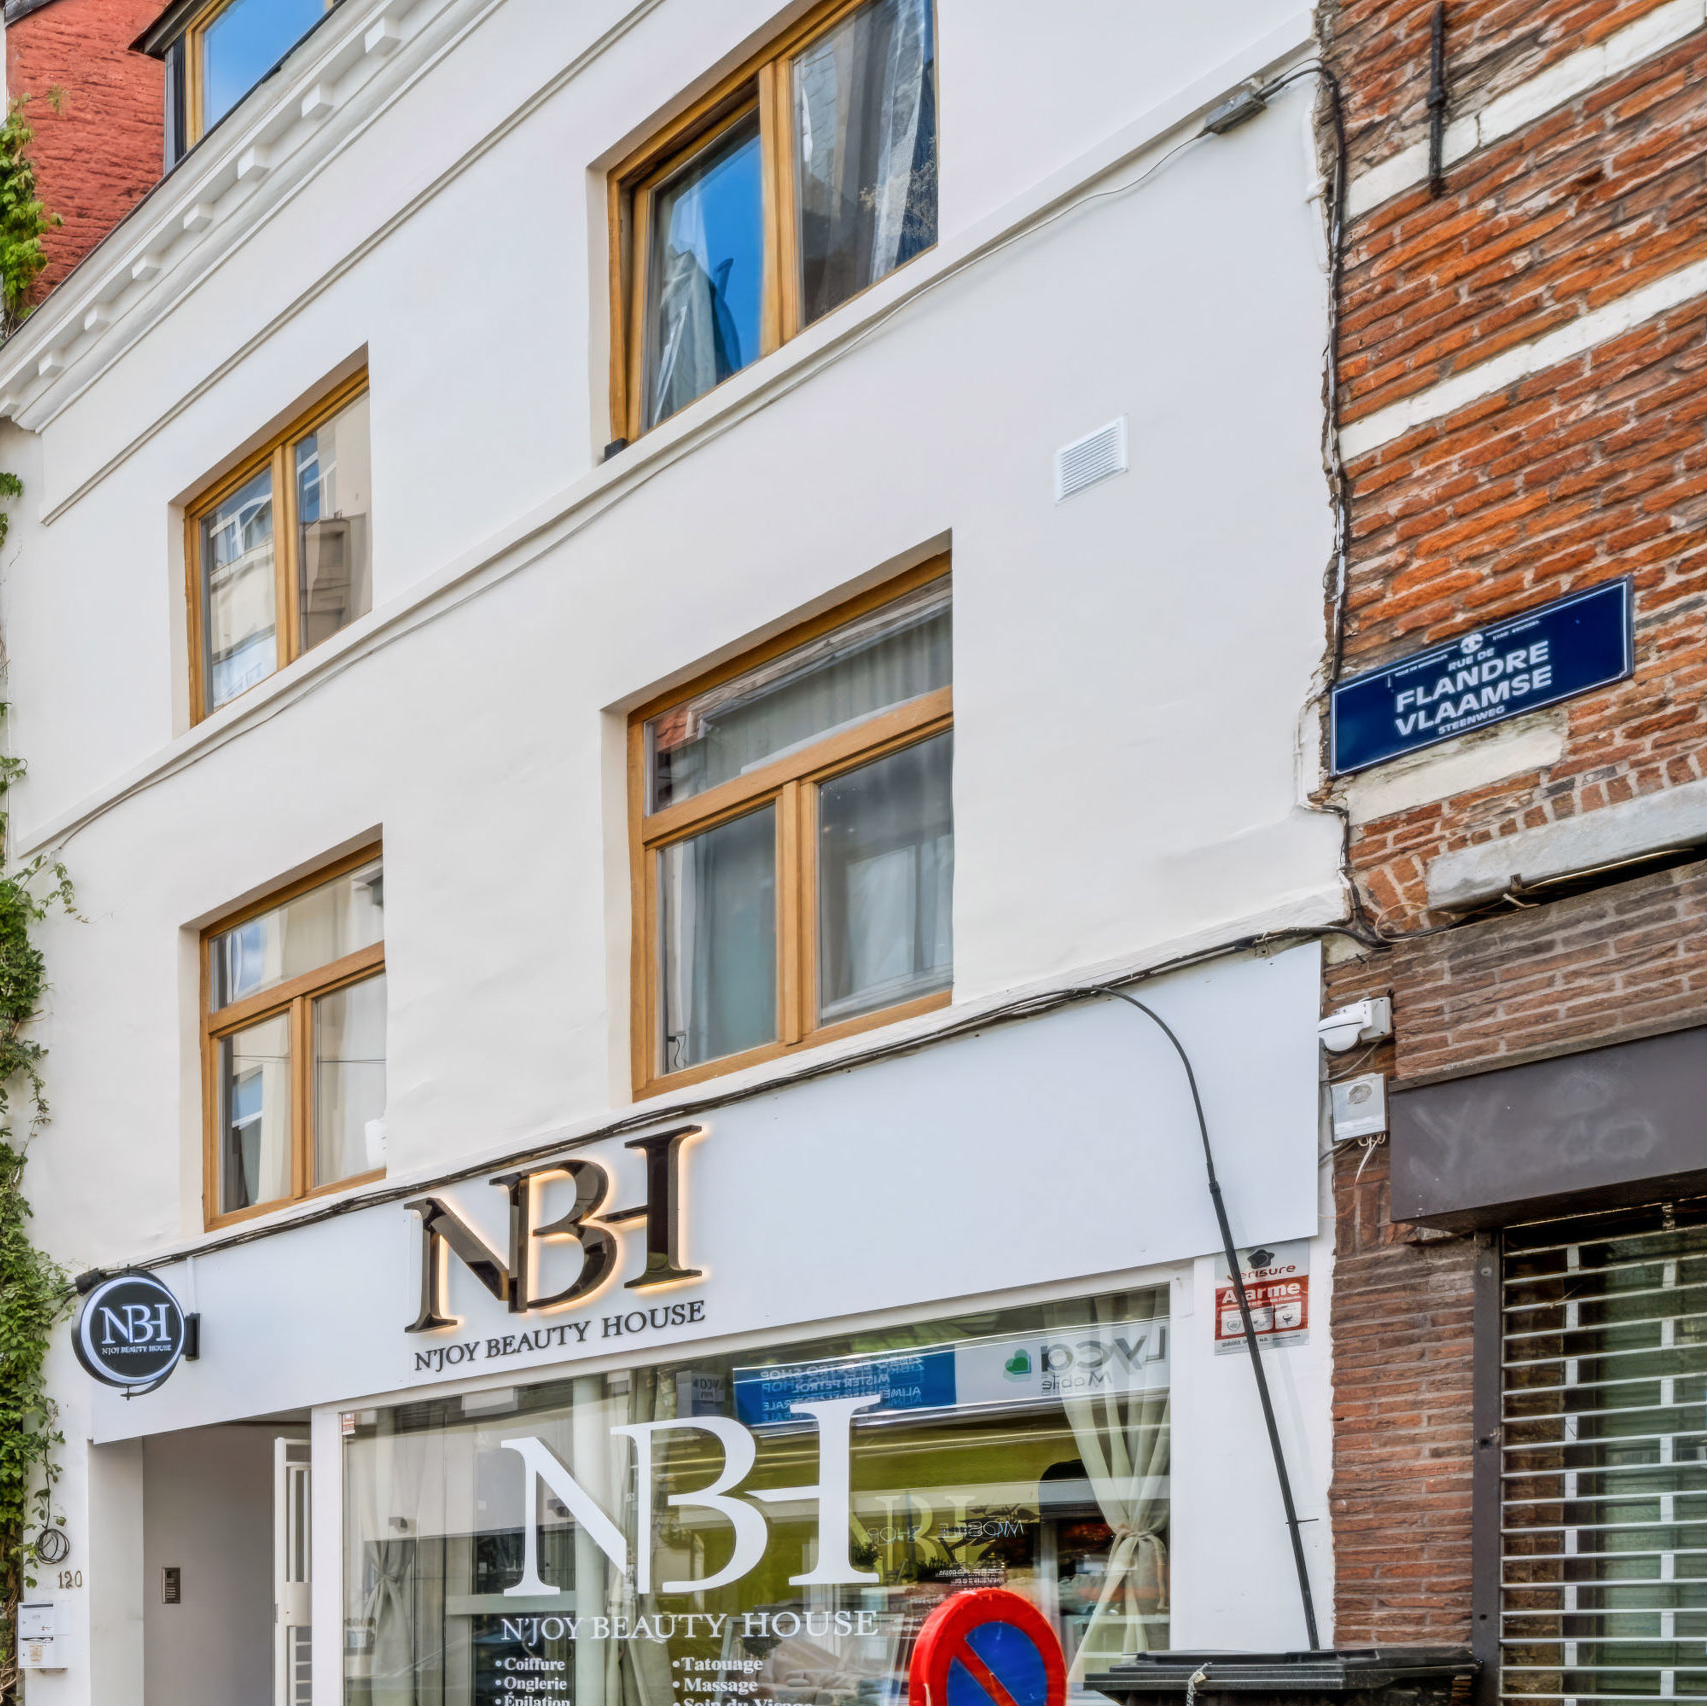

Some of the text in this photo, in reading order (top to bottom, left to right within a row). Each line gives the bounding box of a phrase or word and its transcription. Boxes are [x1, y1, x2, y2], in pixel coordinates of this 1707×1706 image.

[1448, 655, 1474, 672] RUE
[1477, 648, 1495, 662] DE
[1396, 640, 1549, 713] FLANDRE
[1395, 665, 1552, 736] VLAAMSE
[1438, 705, 1506, 735] STEENWEG
[403, 1124, 703, 1334] NBH
[1226, 1264, 1297, 1282] erisure
[1221, 1282, 1301, 1305] Aarme
[98, 1303, 172, 1345] NBH
[414, 1299, 706, 1372] N'JOY BEAUTY HOUSE
[500, 1393, 881, 1598] NBH
[57, 1569, 83, 1589] 120
[500, 1609, 880, 1648] N'JOY BEAUTY HOUSE
[503, 1656, 566, 1672] Coiffure
[681, 1656, 764, 1675] Tatouage
[503, 1676, 568, 1693] Onglerie
[683, 1677, 759, 1695] Massage
